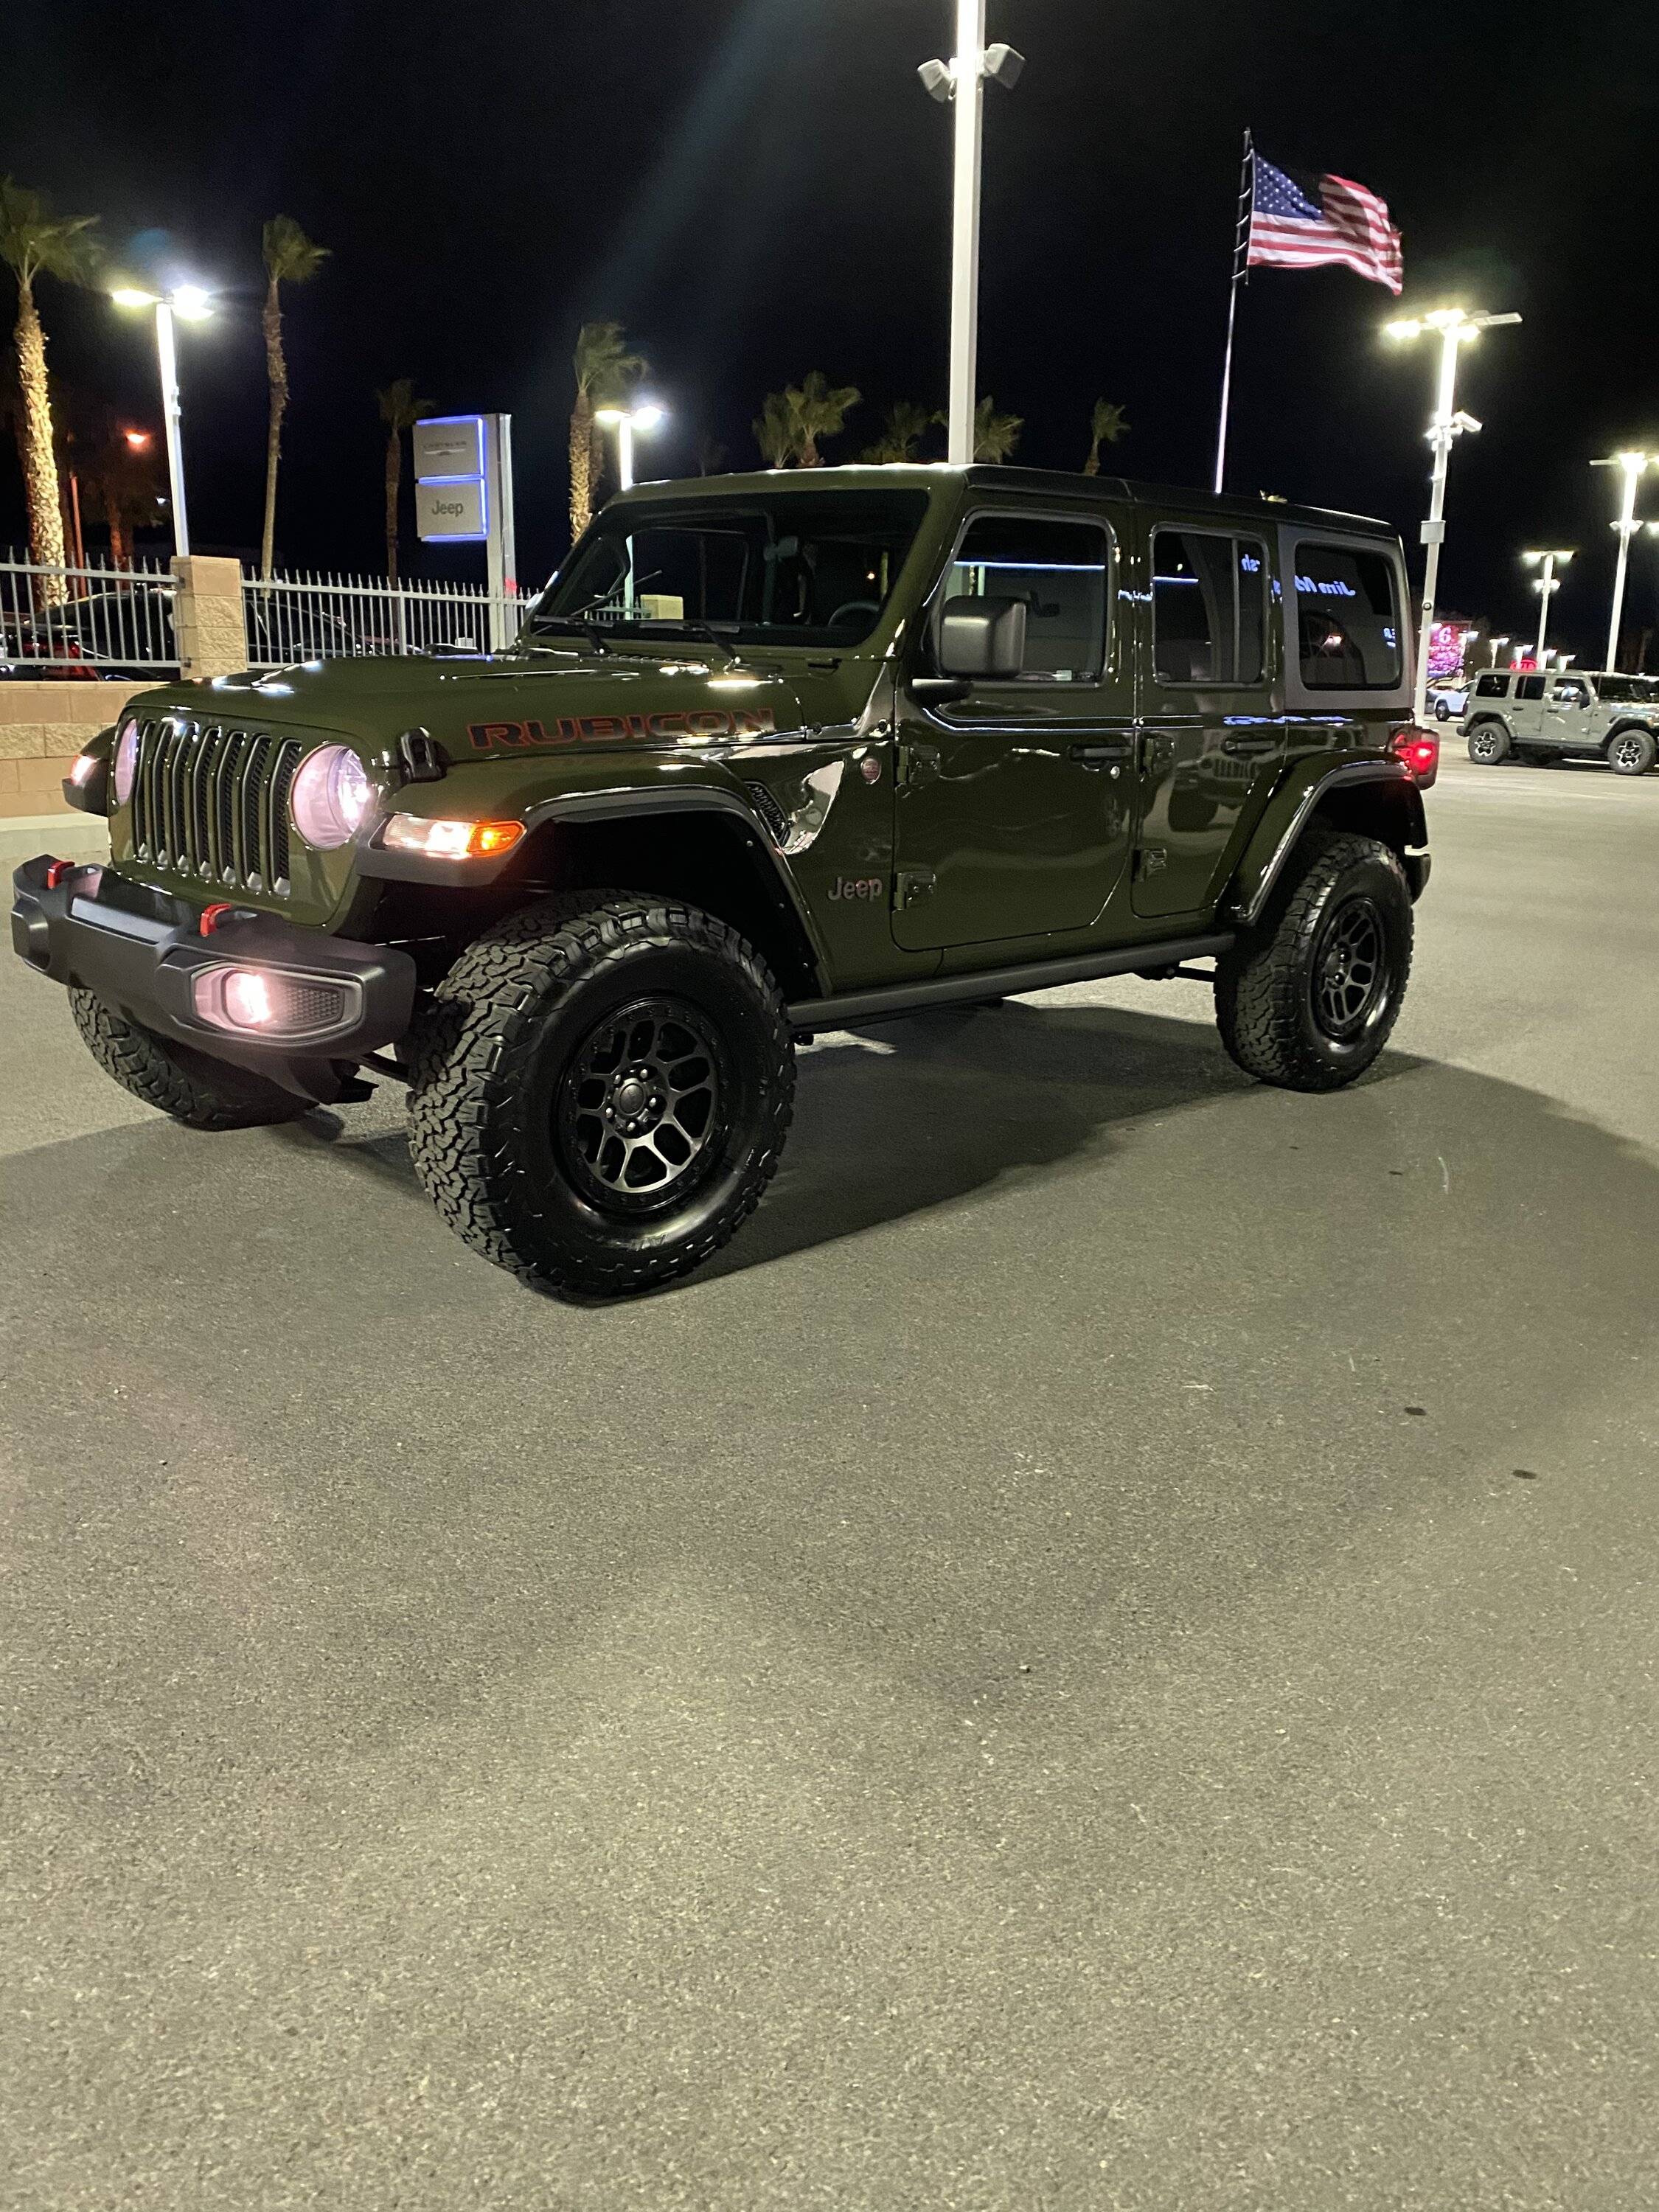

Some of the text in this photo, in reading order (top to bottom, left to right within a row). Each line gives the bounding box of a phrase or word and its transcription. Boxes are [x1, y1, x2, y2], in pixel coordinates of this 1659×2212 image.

[431, 500, 464, 517] Jeep
[466, 709, 775, 750] RUBICON
[827, 877, 883, 901] Jeep
